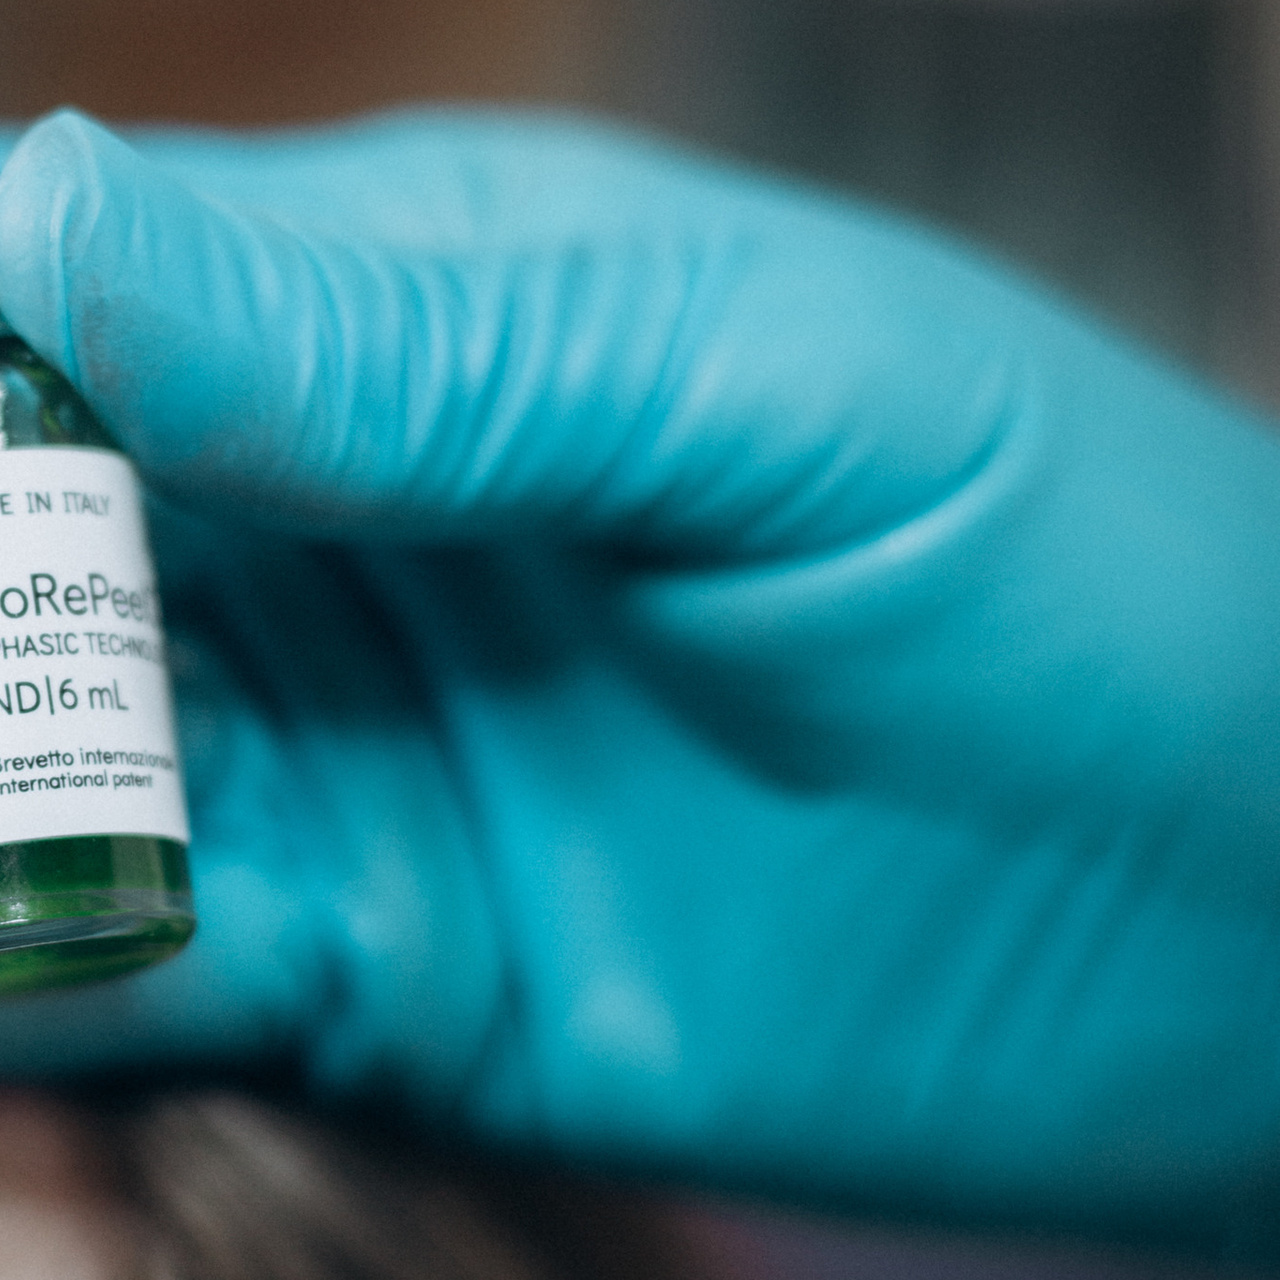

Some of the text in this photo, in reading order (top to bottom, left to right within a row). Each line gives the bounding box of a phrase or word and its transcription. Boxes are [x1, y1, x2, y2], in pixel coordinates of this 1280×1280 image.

[25, 491, 52, 514] IN
[62, 491, 110, 516] ITALY
[88, 678, 129, 711] mL
[113, 772, 153, 791] patent
